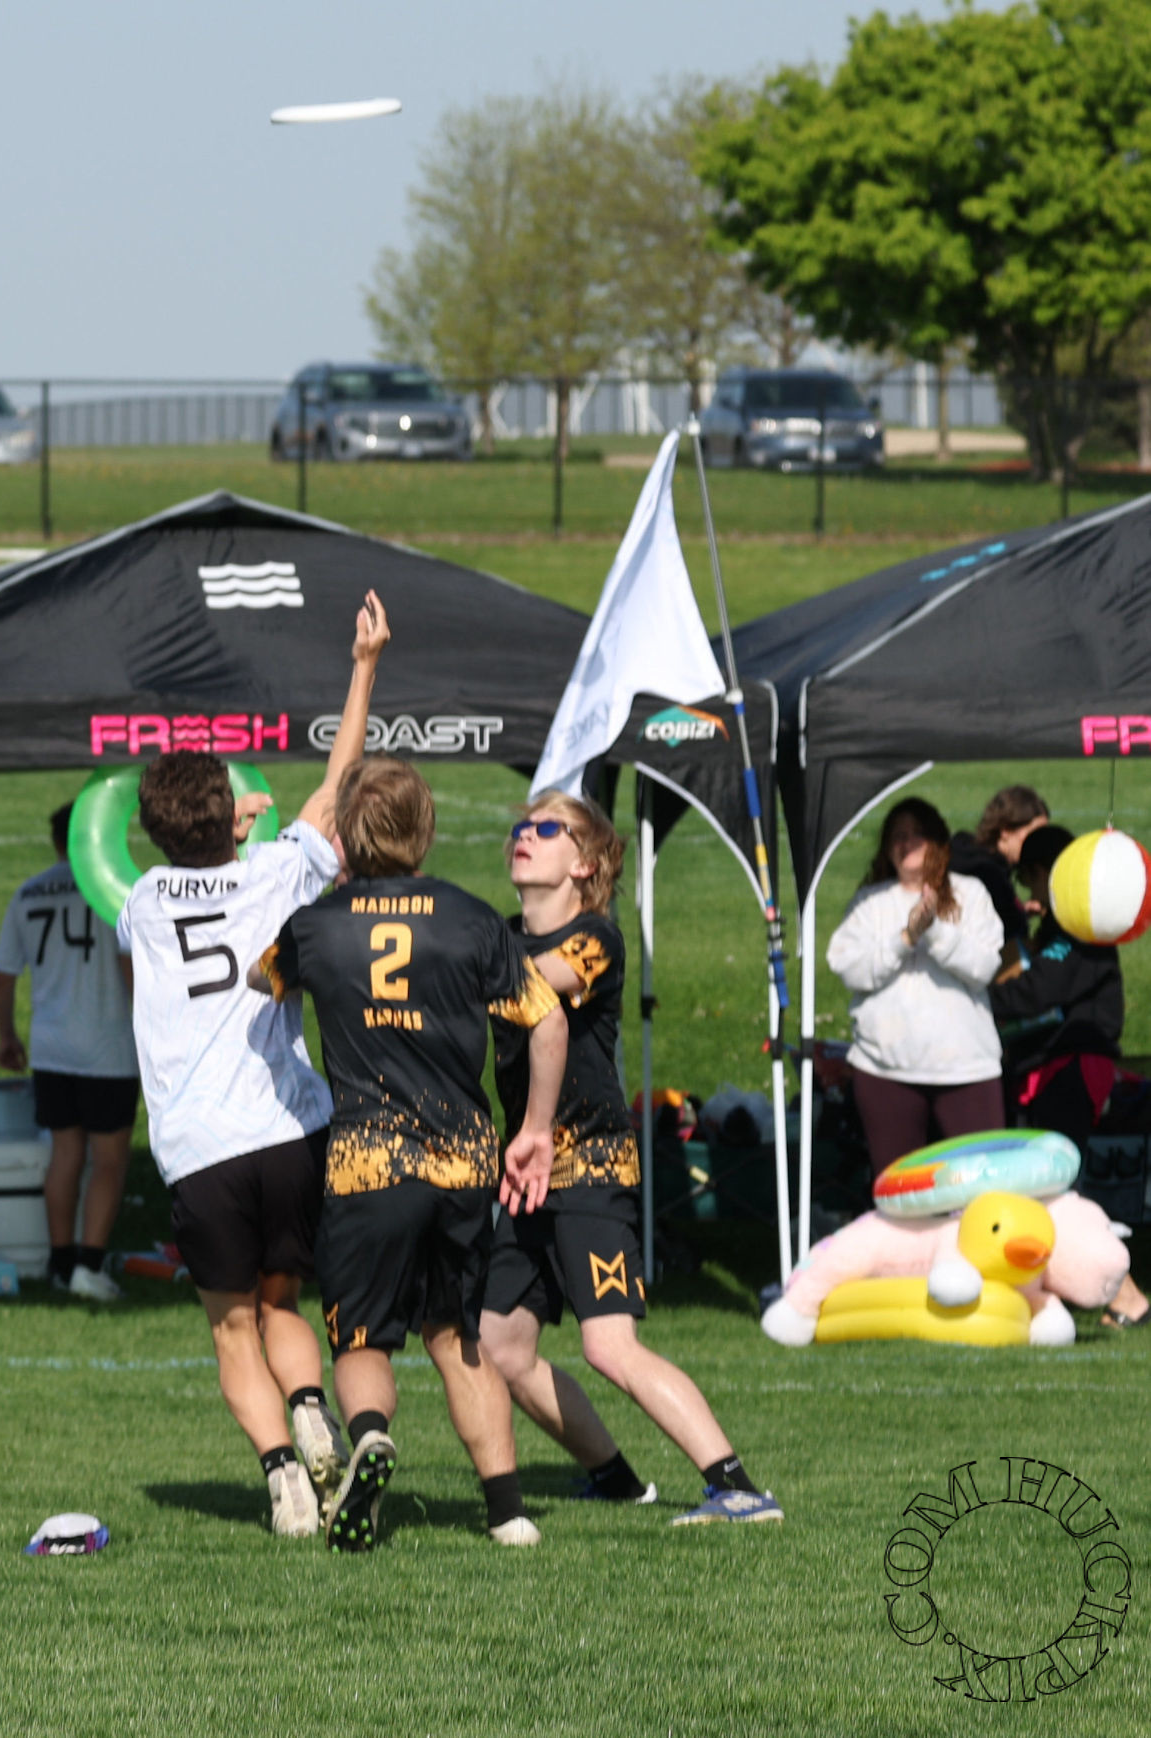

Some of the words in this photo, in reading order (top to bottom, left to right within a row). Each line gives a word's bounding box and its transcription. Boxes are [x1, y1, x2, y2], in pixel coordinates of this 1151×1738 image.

[91, 714, 289, 756] FRESH
[308, 714, 503, 753] COAST
[645, 719, 716, 742] COBIZI
[351, 895, 434, 915] MADISON
[27, 905, 96, 966] 74
[174, 912, 239, 1000] 5
[370, 922, 412, 1001] 2
